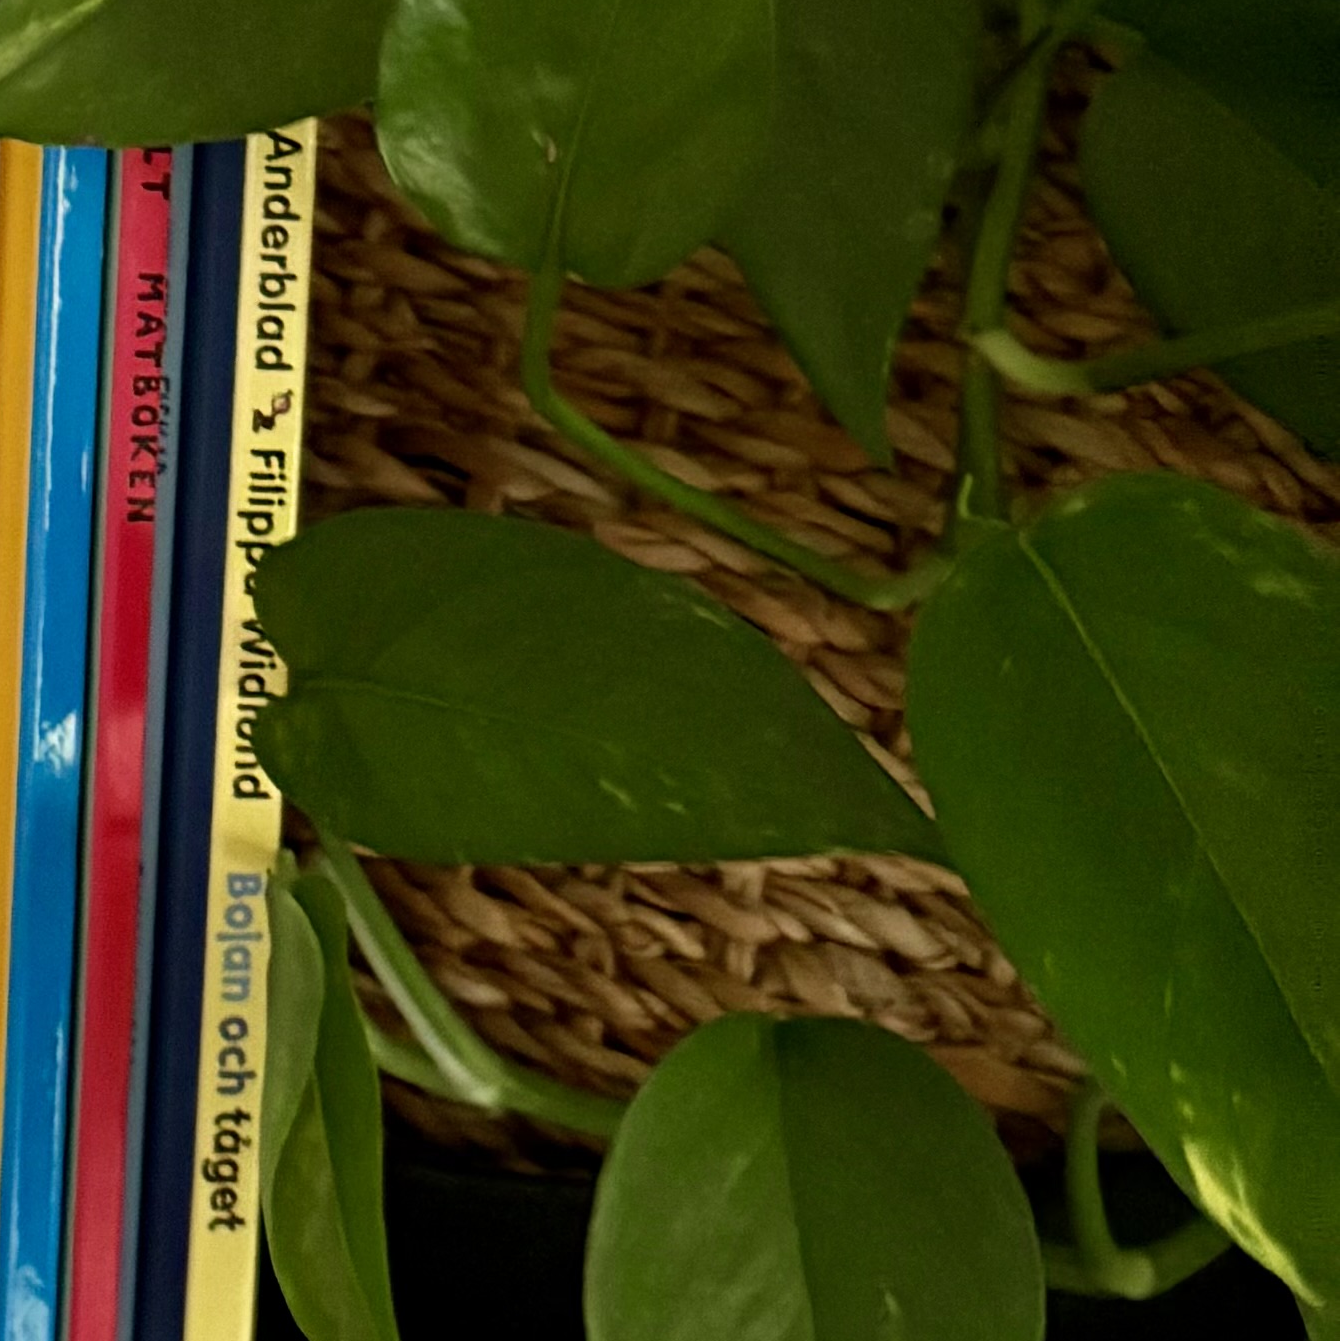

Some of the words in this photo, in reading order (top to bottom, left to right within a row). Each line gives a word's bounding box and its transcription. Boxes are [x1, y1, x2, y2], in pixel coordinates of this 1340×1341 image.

[256, 129, 303, 371] Anderblad
[126, 271, 167, 524] MATBOKEN
[216, 872, 267, 1003] Bojan
[216, 1017, 257, 1094] och
[202, 1109, 252, 1231] tåget
